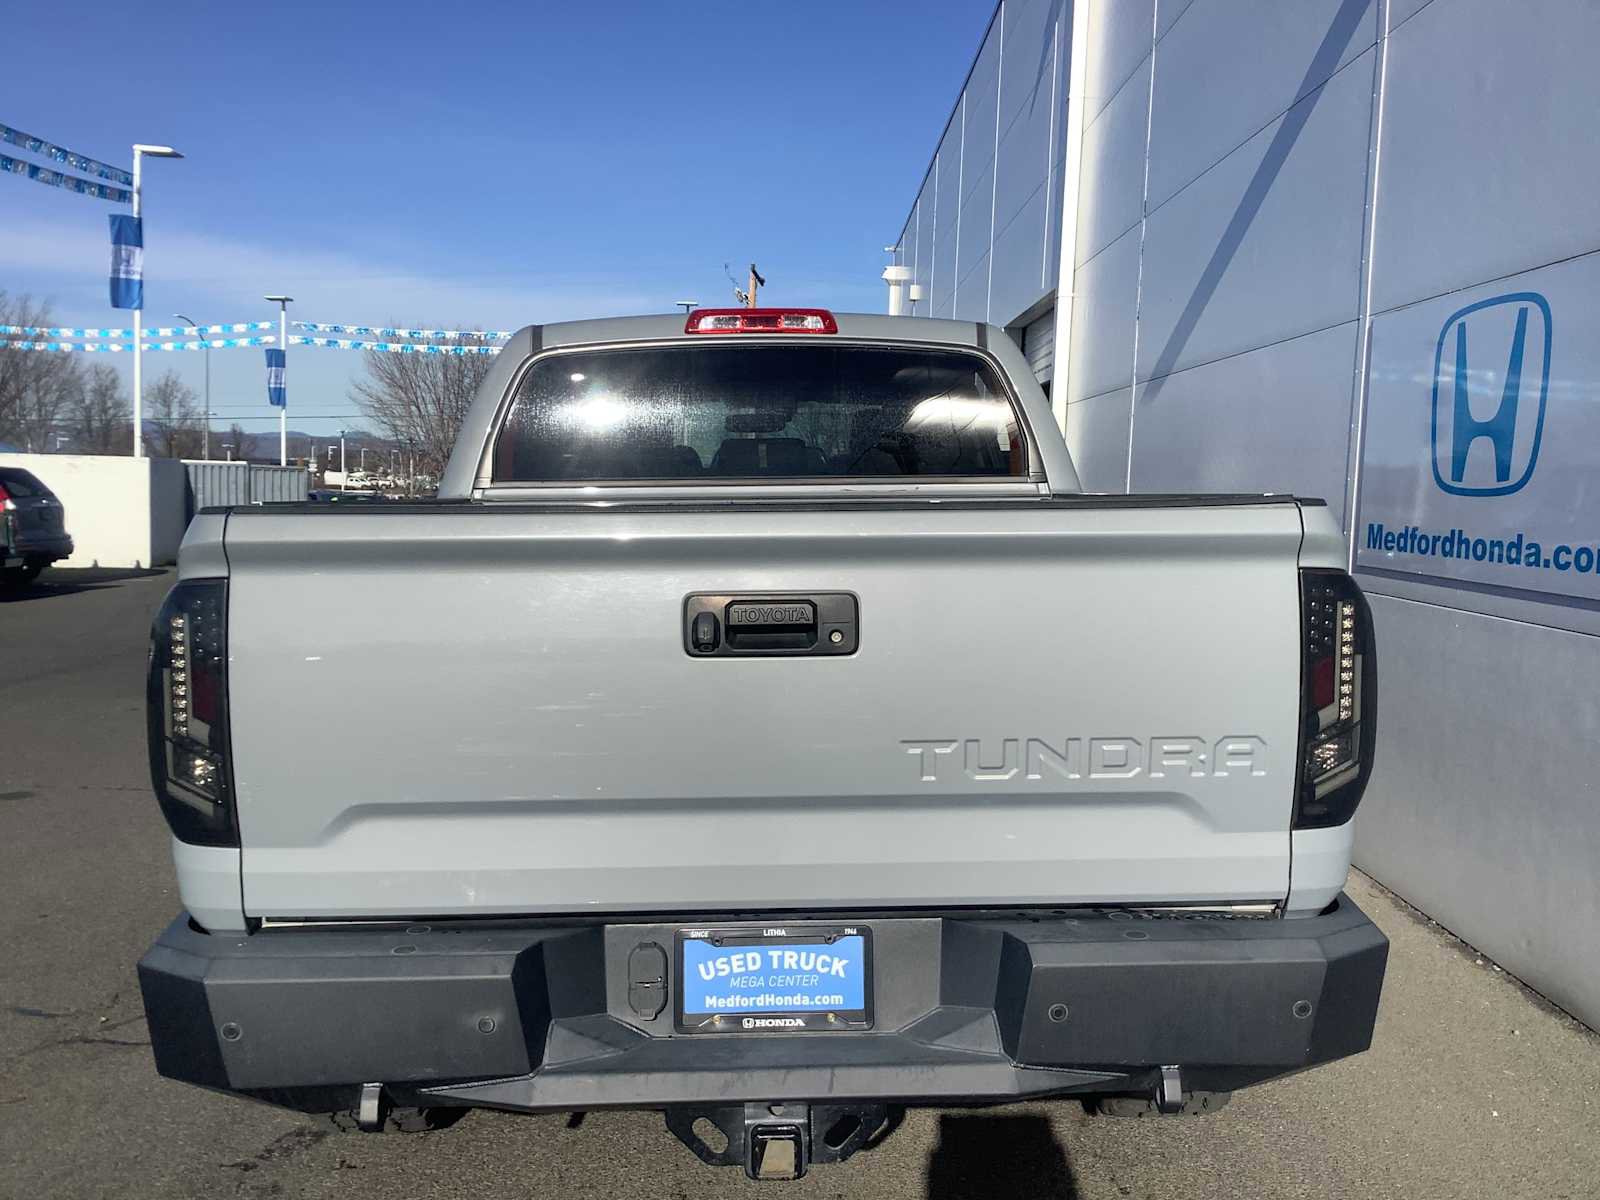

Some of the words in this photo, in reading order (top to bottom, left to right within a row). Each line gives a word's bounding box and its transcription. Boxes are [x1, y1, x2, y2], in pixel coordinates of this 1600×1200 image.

[1367, 523, 1600, 574] Medfordhonda.co
[733, 607, 810, 623] TOYOTA
[900, 735, 1267, 780] TUNDRA
[763, 929, 786, 937] LITHIA
[698, 951, 761, 981] USED
[768, 950, 848, 978] TRUCK
[730, 976, 765, 988] MEGA
[769, 975, 819, 987] CENTER
[705, 993, 843, 1008] MedfordHonda.com
[755, 1018, 806, 1027] HONDA
